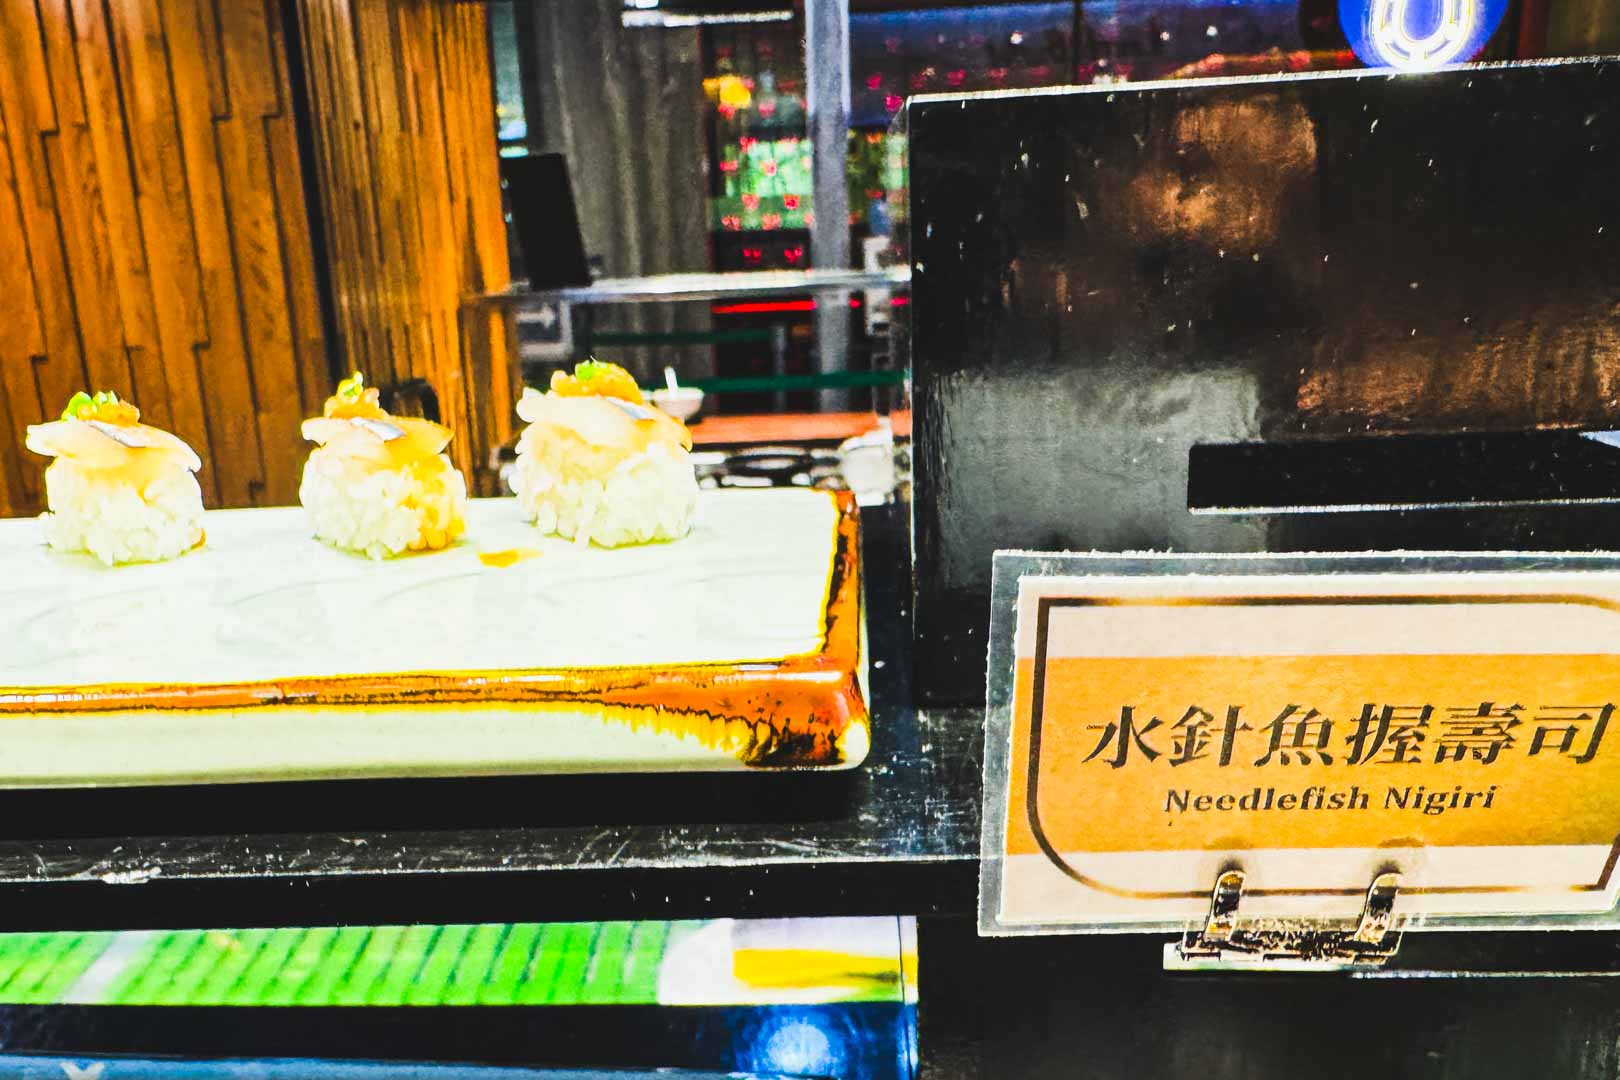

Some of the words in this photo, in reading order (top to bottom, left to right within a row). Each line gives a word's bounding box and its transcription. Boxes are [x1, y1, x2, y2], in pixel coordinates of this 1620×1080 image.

[1081, 701, 1617, 768] 水針魚握壽司
[1165, 786, 1369, 812] Needlefish
[1384, 785, 1497, 815] Nigiri
